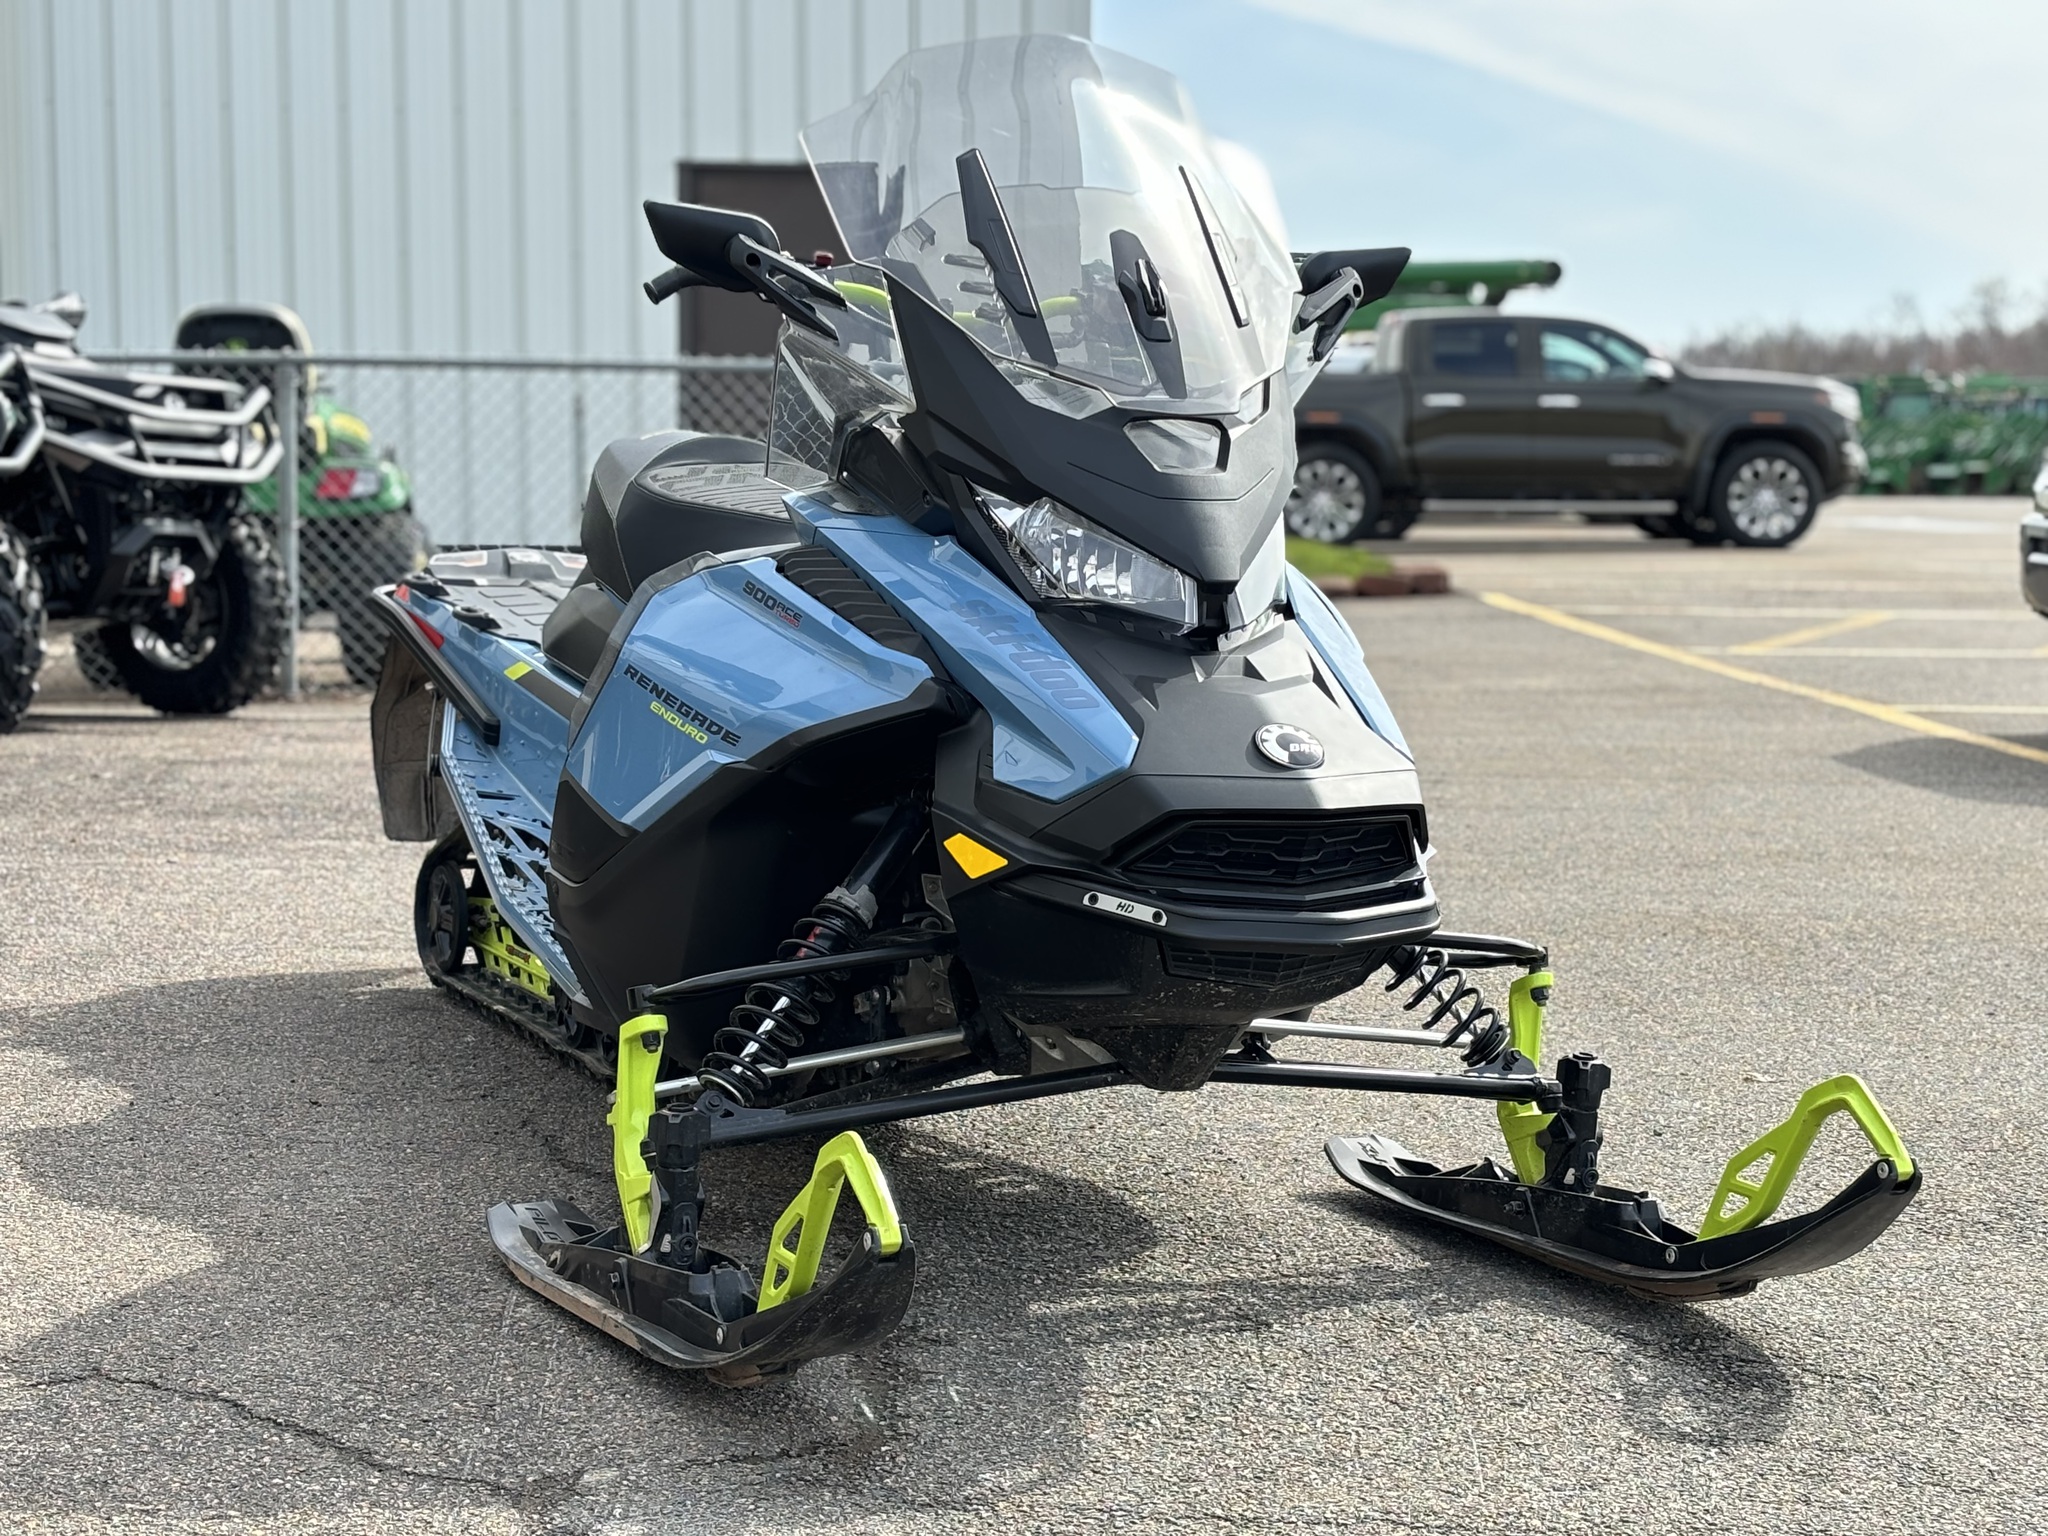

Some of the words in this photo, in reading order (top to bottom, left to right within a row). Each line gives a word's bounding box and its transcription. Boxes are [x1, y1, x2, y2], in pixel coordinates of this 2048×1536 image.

[743, 580, 777, 611] 900
[776, 602, 803, 622] ACE
[774, 609, 800, 628] TURBO
[623, 663, 742, 747] RENEGADE
[650, 701, 708, 744] ENDURO
[1115, 901, 1135, 914] HD
[524, 1206, 567, 1243] PILO
